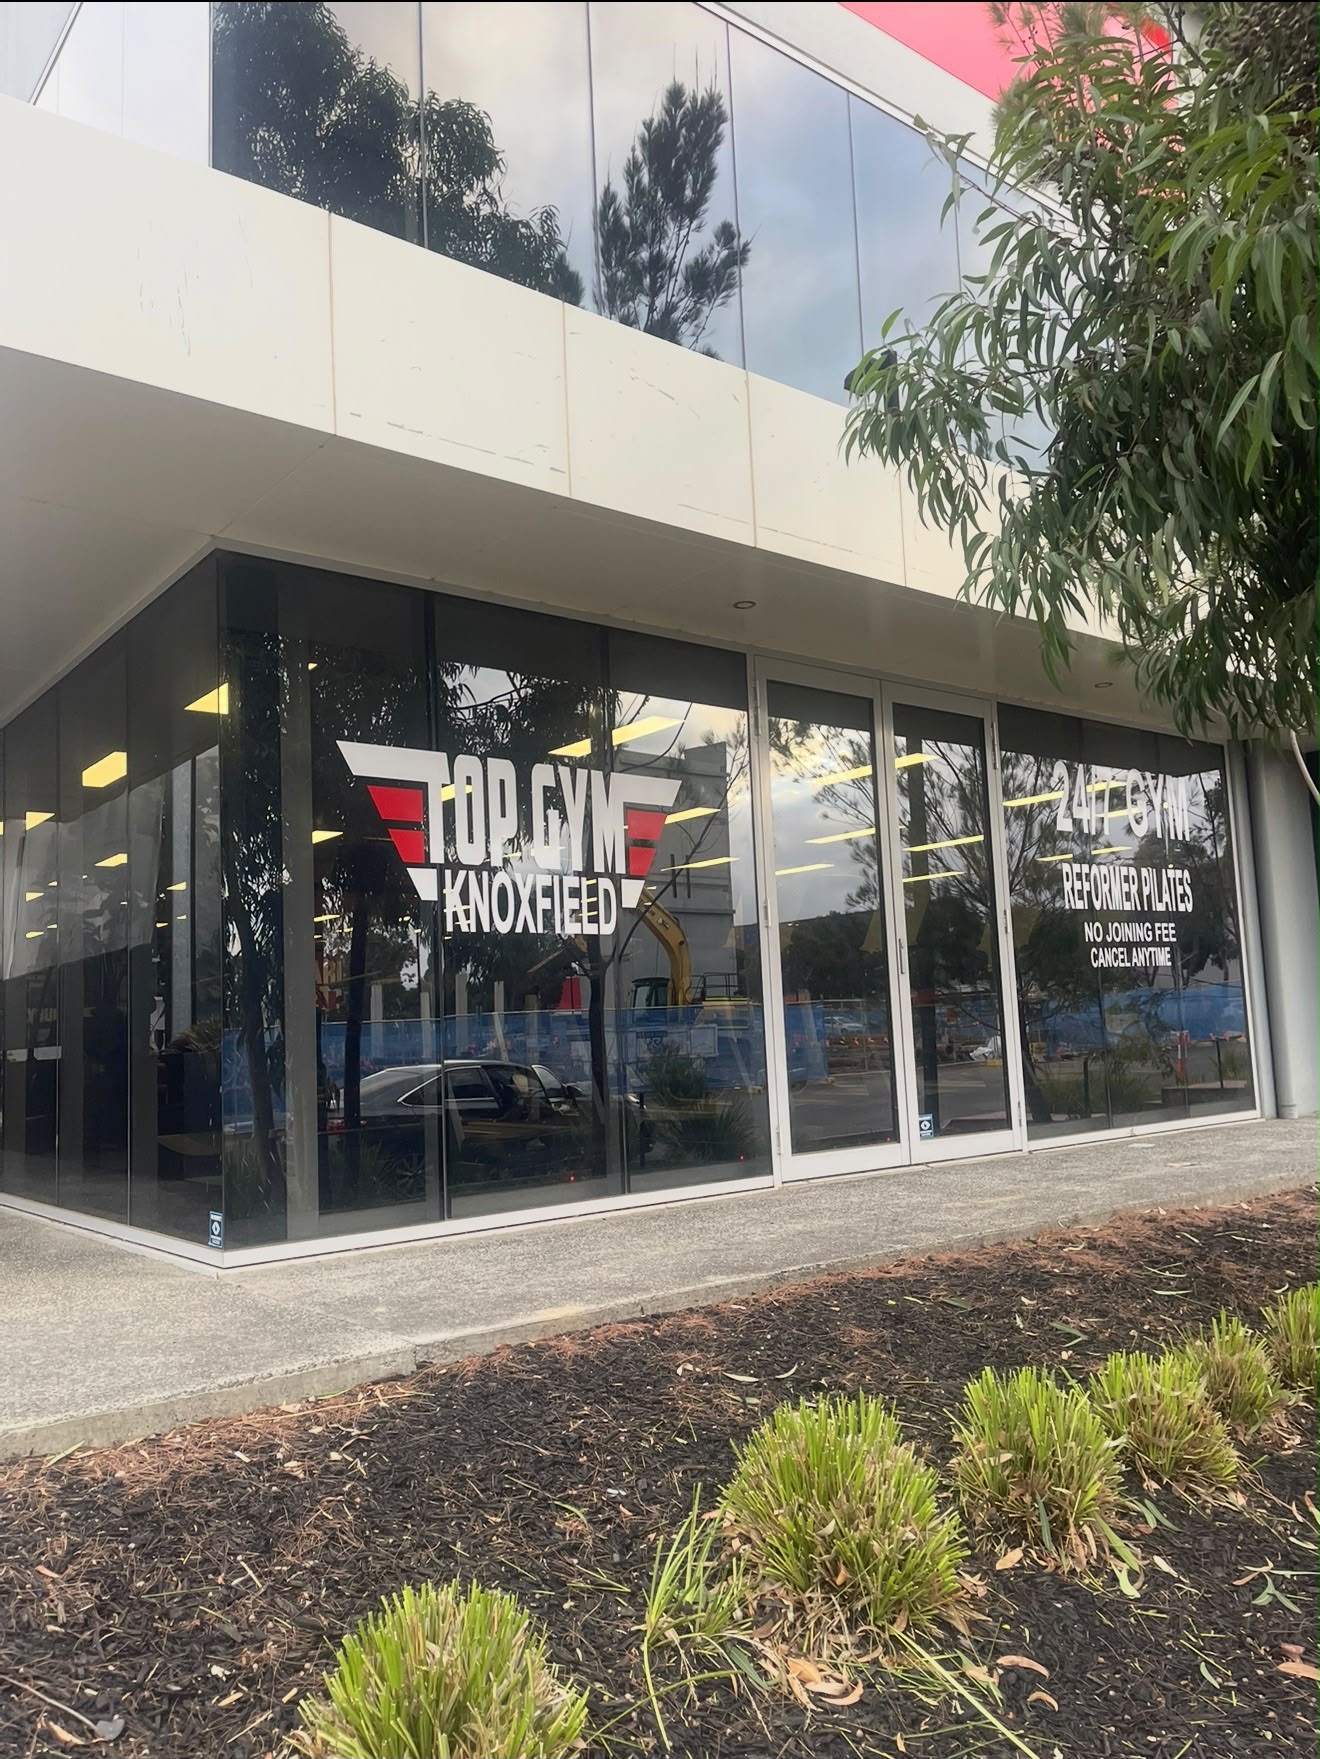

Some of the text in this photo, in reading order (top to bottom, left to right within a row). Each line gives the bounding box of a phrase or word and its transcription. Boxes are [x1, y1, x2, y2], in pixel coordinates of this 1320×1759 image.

[336, 740, 682, 874] TOP GYM
[1051, 760, 1190, 842] 24/7 GYM
[443, 869, 617, 935] KNOXFIELD
[1062, 863, 1193, 912] REFORMER PILATES
[1084, 922, 1176, 942] NO JOINING FEE
[1090, 947, 1171, 968] CANCEL ANYTIME
